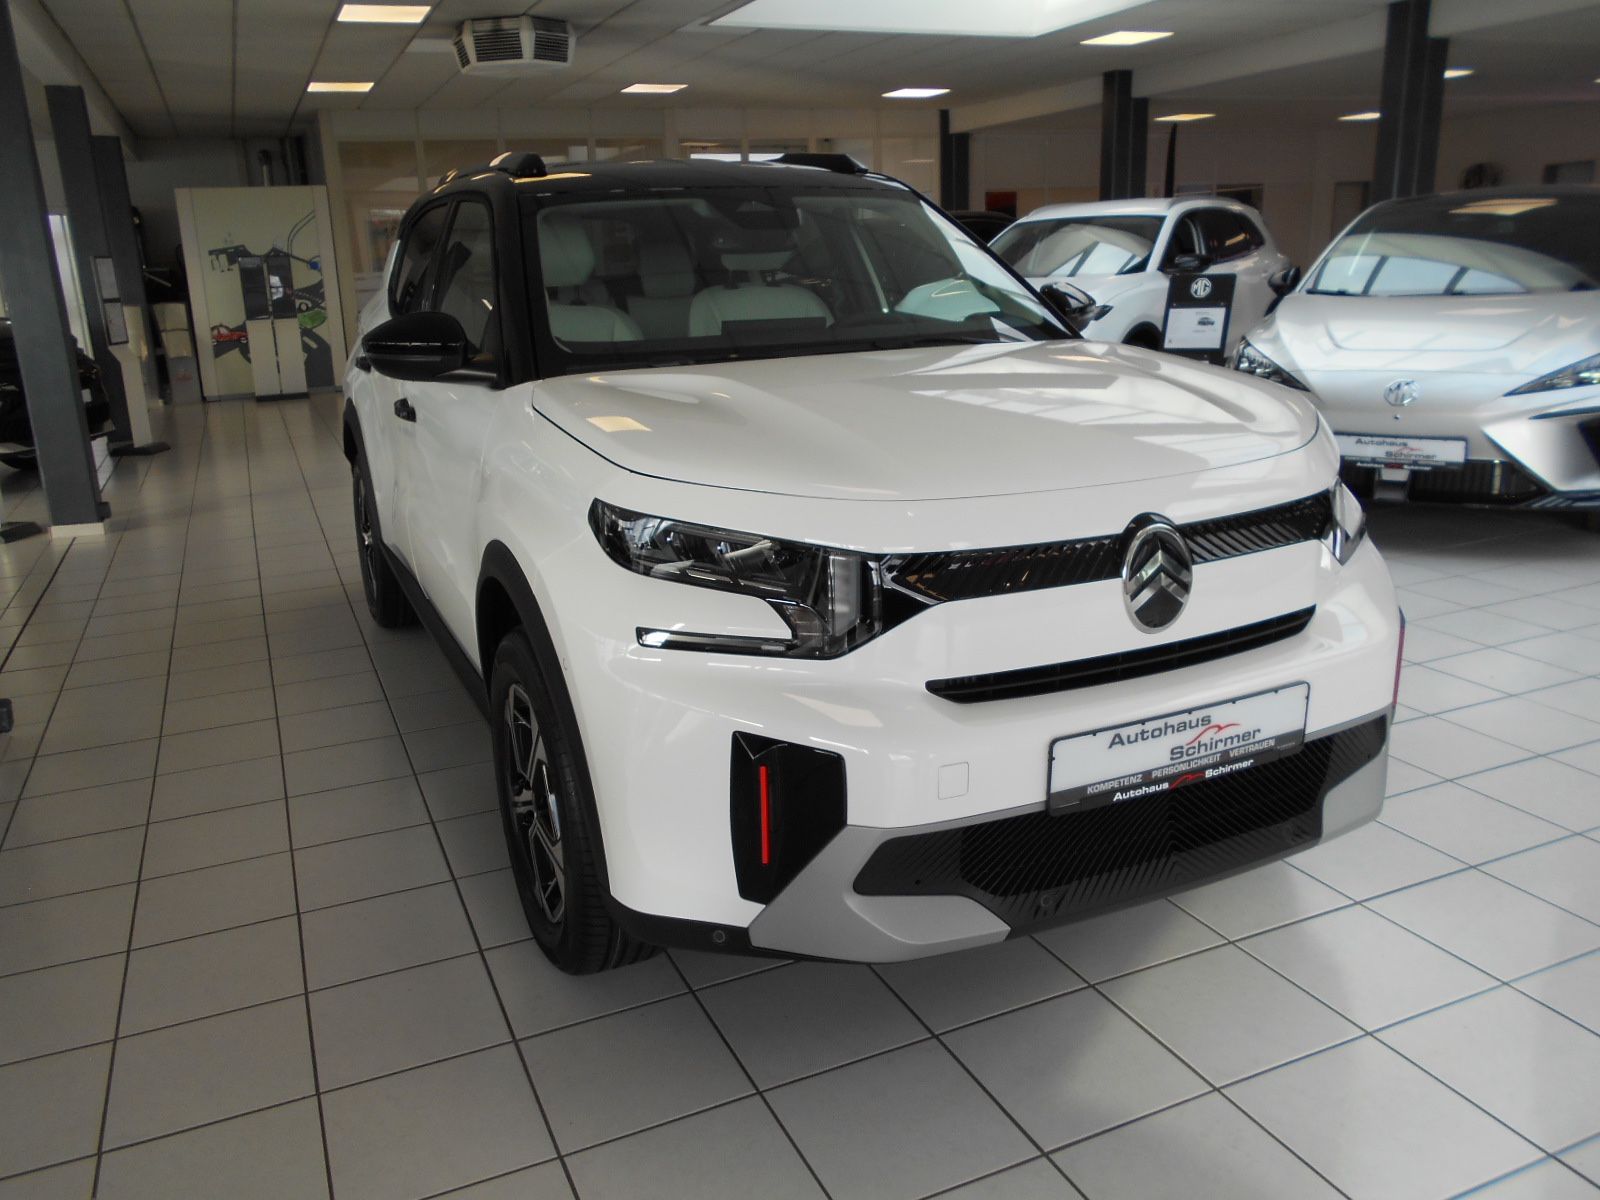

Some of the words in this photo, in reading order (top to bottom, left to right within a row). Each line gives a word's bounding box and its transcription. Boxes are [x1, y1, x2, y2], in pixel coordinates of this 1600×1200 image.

[1192, 279, 1211, 296] MG
[1386, 381, 1417, 405] MG
[1355, 438, 1408, 447] Autohaus
[1385, 450, 1437, 459] Schirmer
[1108, 715, 1212, 749] Autohaus
[1169, 727, 1261, 761] Schirmer
[1086, 773, 1143, 794] KOMPETENZ
[1229, 738, 1275, 758] VERTRAUEN
[1112, 782, 1169, 802] Autohaus
[1204, 758, 1254, 779] Schirmer
